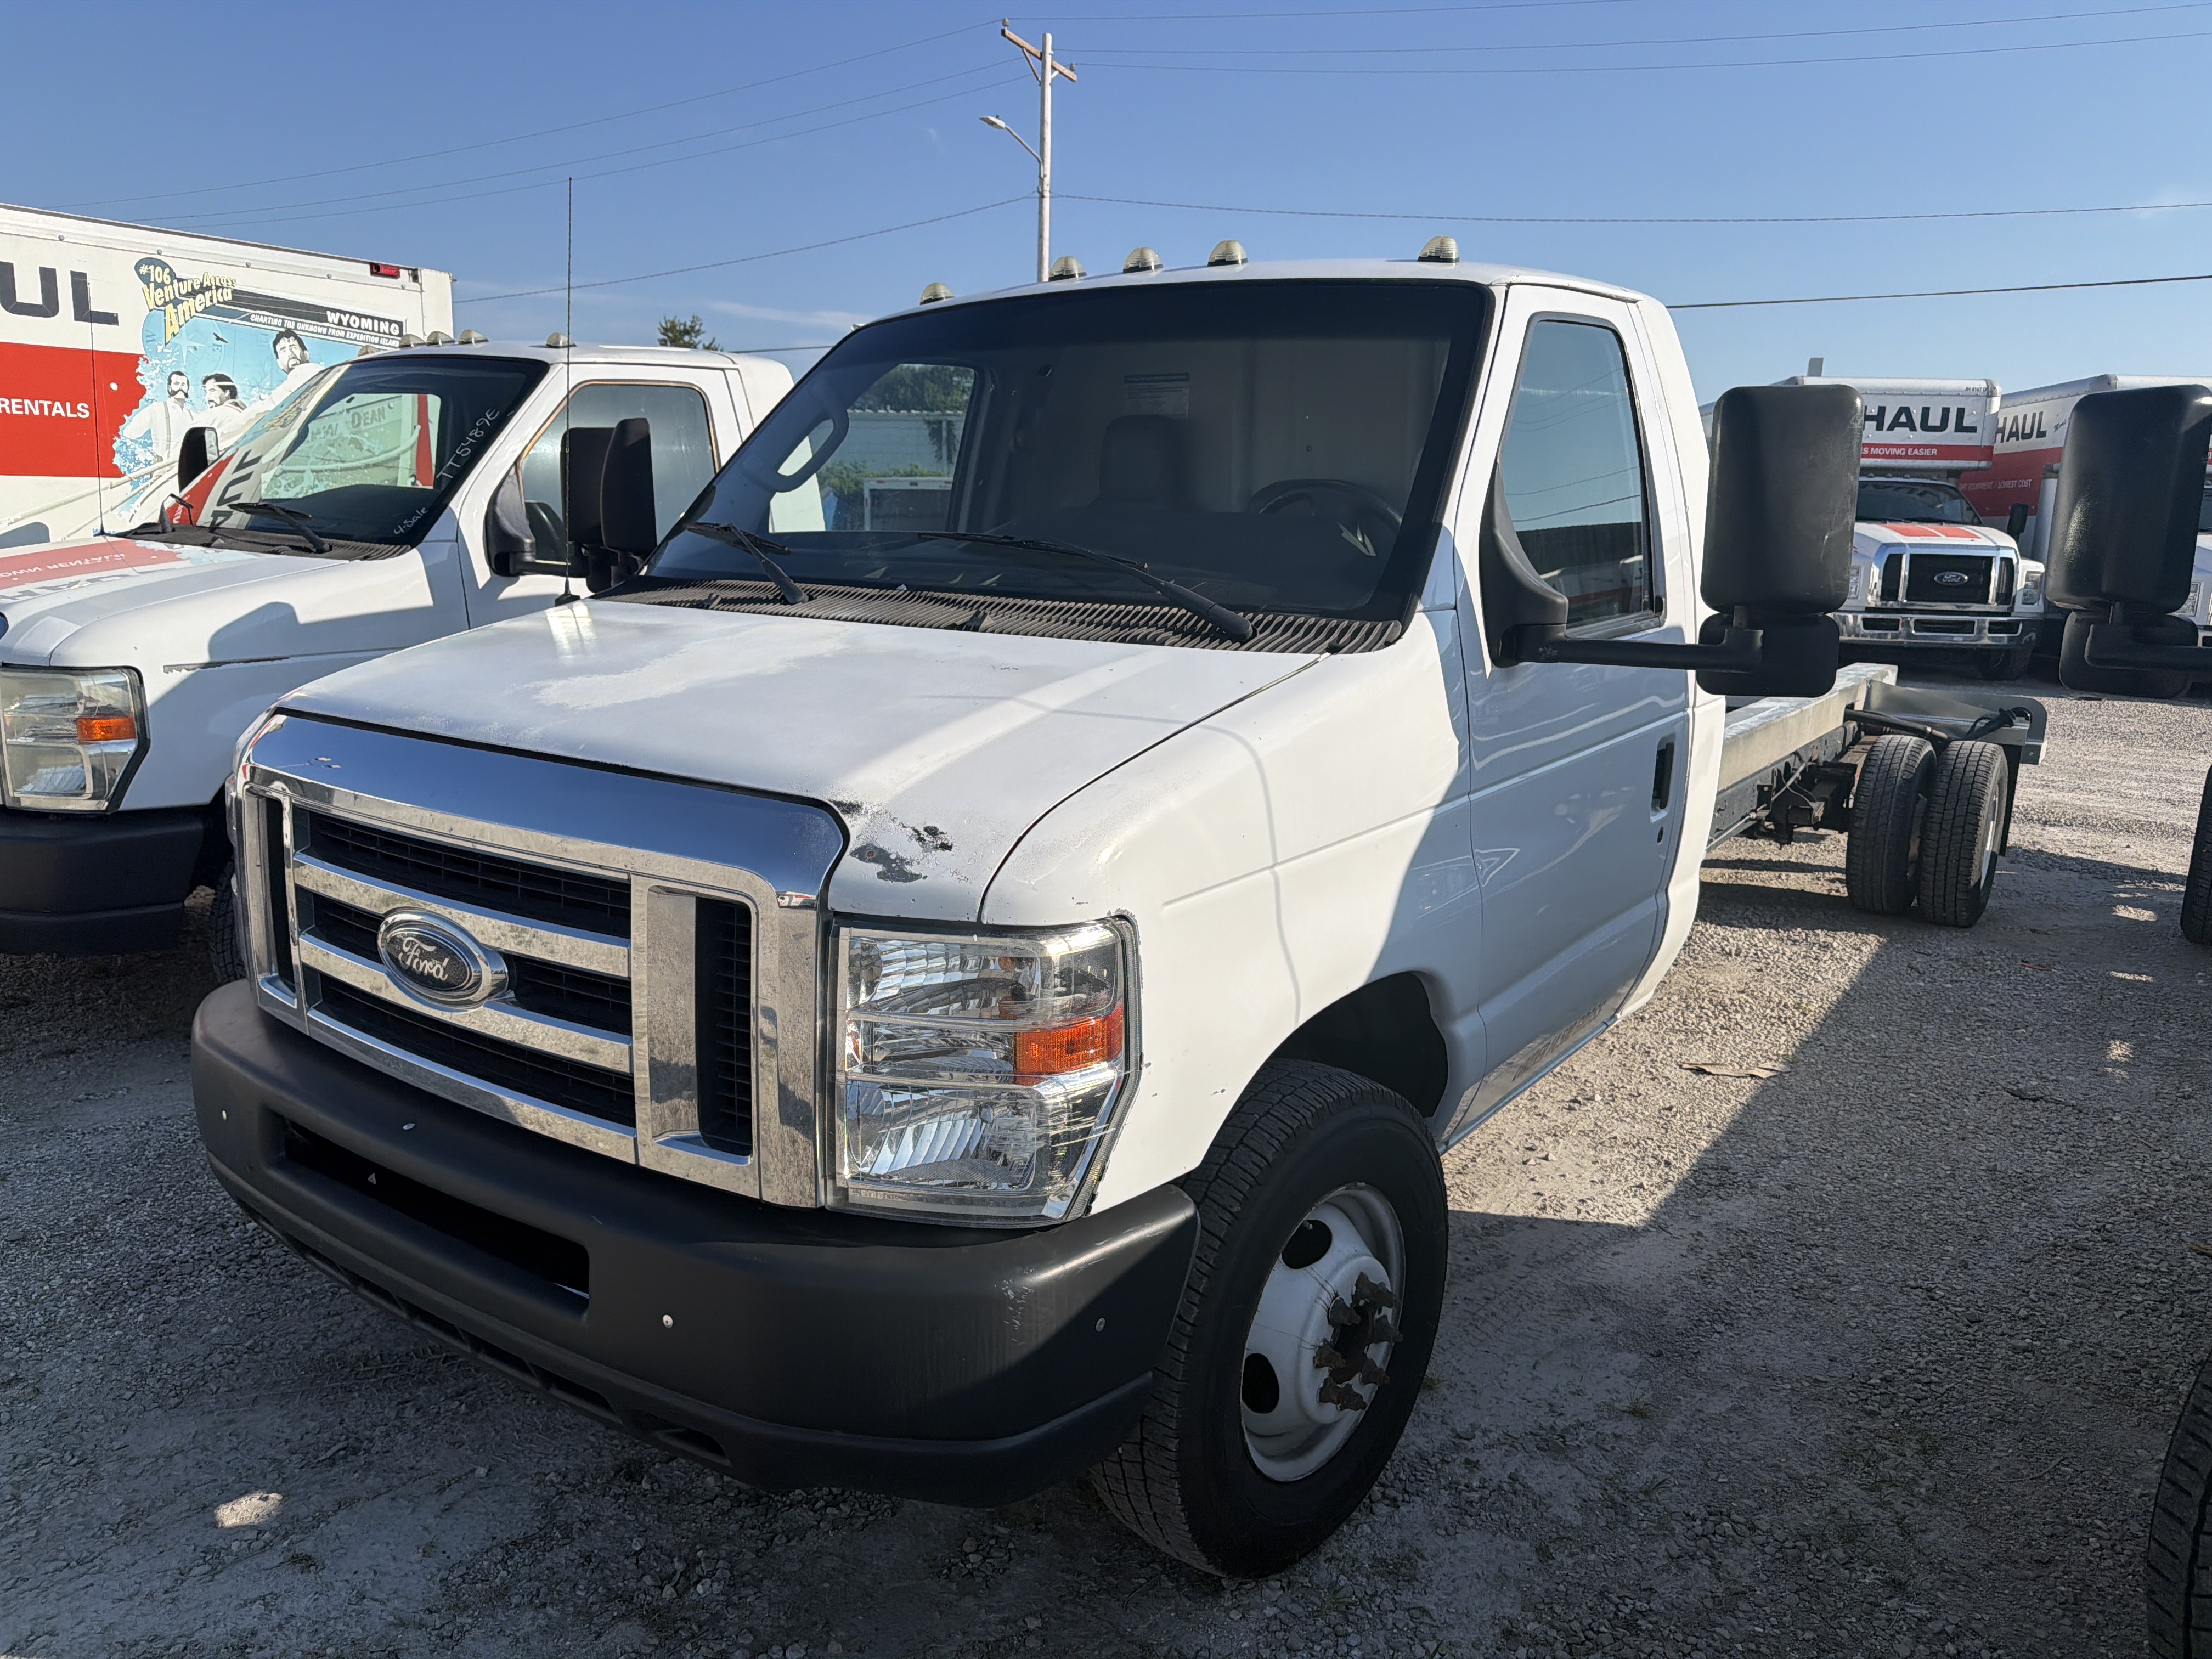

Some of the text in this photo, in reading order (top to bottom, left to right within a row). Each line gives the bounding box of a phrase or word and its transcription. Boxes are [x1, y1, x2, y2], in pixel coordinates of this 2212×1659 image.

[139, 264, 171, 285] #106
[142, 272, 237, 311] Venture Across
[165, 285, 232, 345] America
[326, 311, 399, 335] WYOMING
[250, 314, 400, 347] CHARTING THE UNKNOWN FROM EXPEDITION ISLAND
[0, 398, 89, 419] RENTALS
[1863, 405, 1978, 433] HAUL
[1994, 411, 2047, 444] HAUL
[1870, 447, 1906, 455] MOVING
[1908, 448, 1938, 456] EASIER
[1997, 480, 2017, 489] LOWEST
[2018, 479, 2032, 488] COST
[398, 936, 450, 981] Ford
